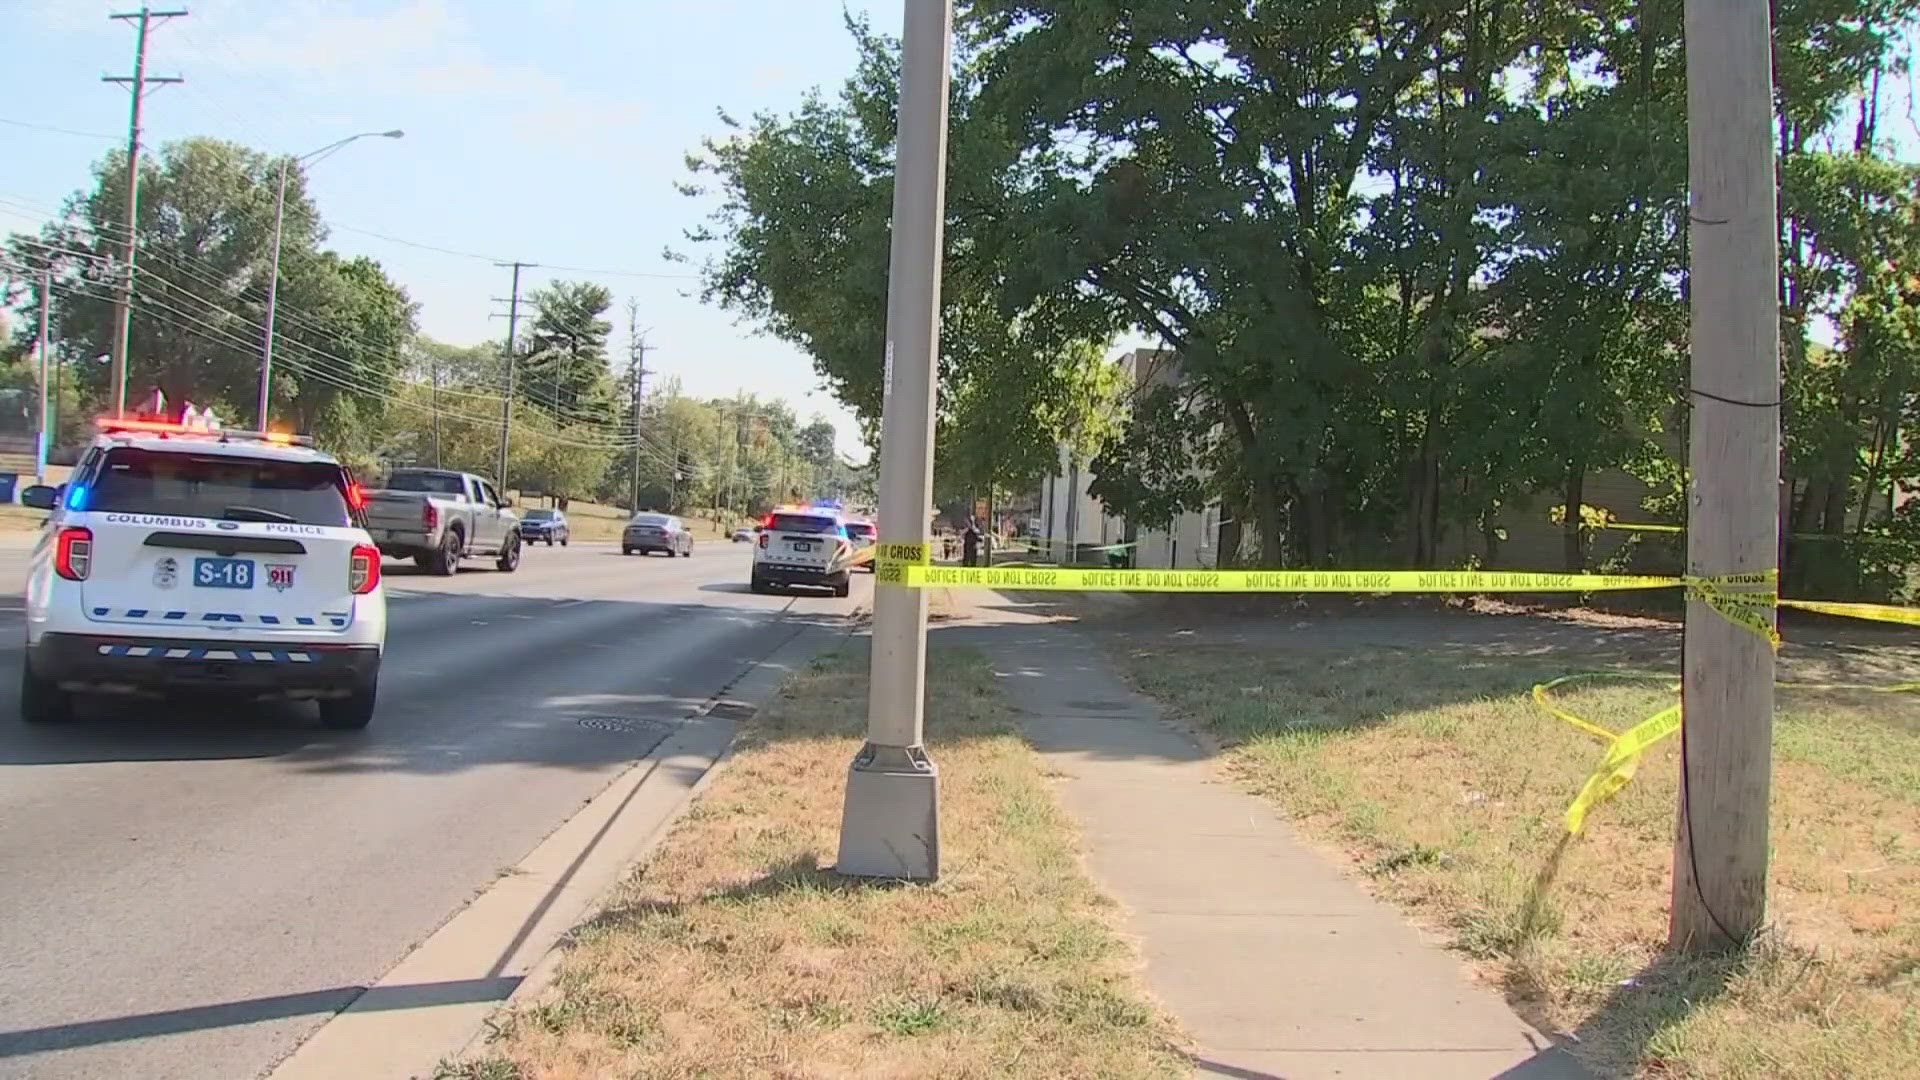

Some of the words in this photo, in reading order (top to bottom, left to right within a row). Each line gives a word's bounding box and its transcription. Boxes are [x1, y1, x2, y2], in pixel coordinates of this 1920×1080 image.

[106, 513, 206, 528] COLUMBUS
[265, 523, 325, 535] POLICE
[890, 545, 921, 561] CROSS
[199, 562, 249, 585] S-18
[270, 569, 292, 583] 911
